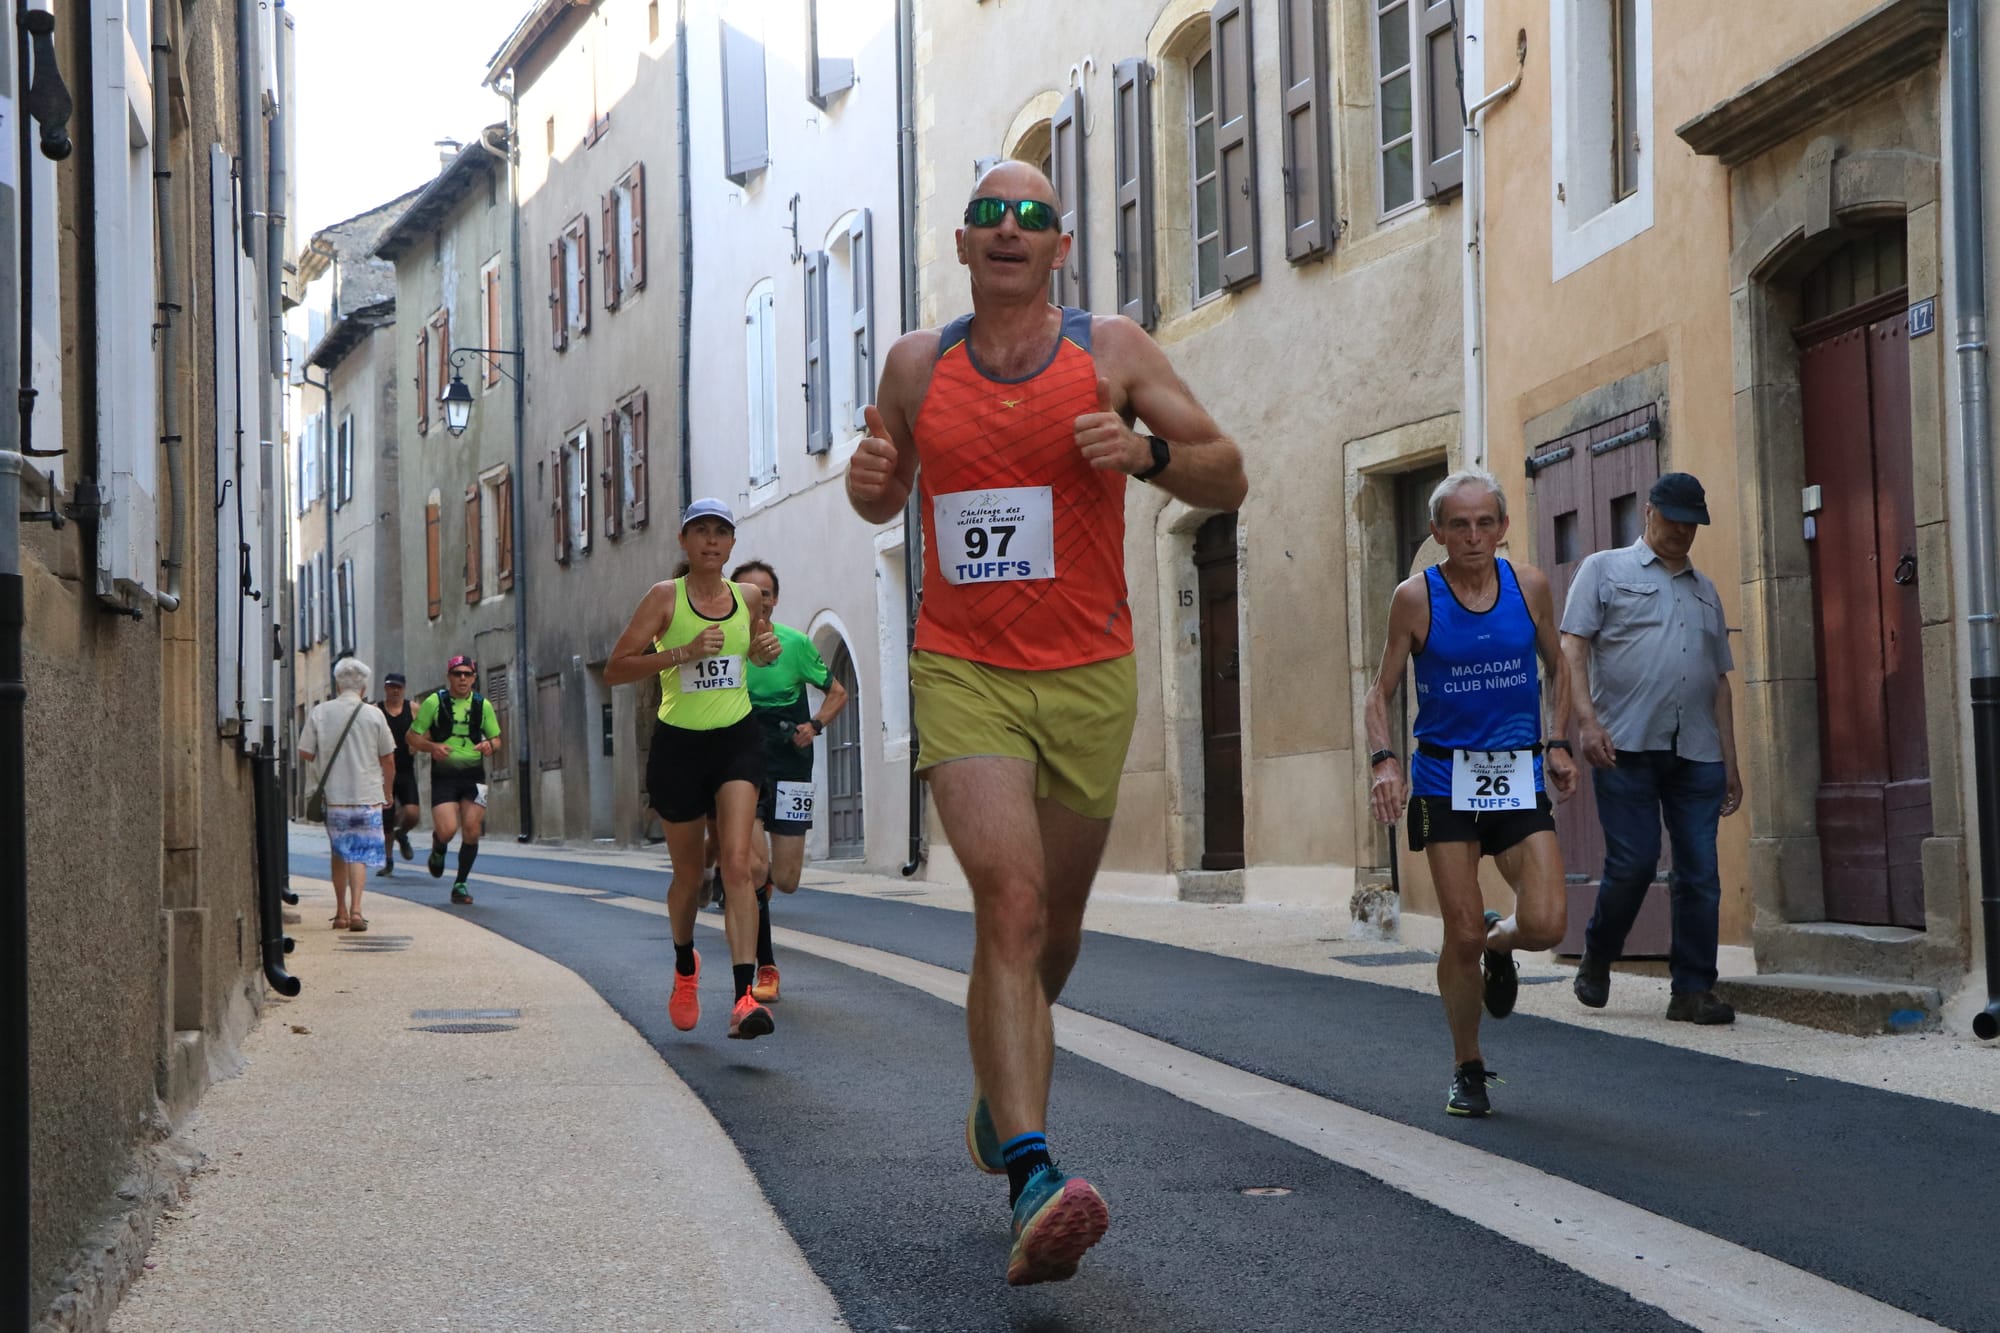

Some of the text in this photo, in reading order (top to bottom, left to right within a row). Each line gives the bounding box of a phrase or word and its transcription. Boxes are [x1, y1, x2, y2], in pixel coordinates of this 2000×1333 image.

[1913, 306, 1929, 331] 17
[964, 525, 1016, 559] 97
[955, 560, 1031, 580] TUFF'S
[1178, 590, 1194, 607] 15
[695, 659, 730, 678] 167
[1451, 658, 1521, 677] MACADAM
[694, 677, 734, 689] TUFF'S
[1443, 680, 1482, 693] CLUB
[1485, 672, 1528, 690] NÎMOIS
[1475, 775, 1511, 796] 26
[792, 797, 812, 811] 39
[1467, 797, 1521, 809] TUFF'S
